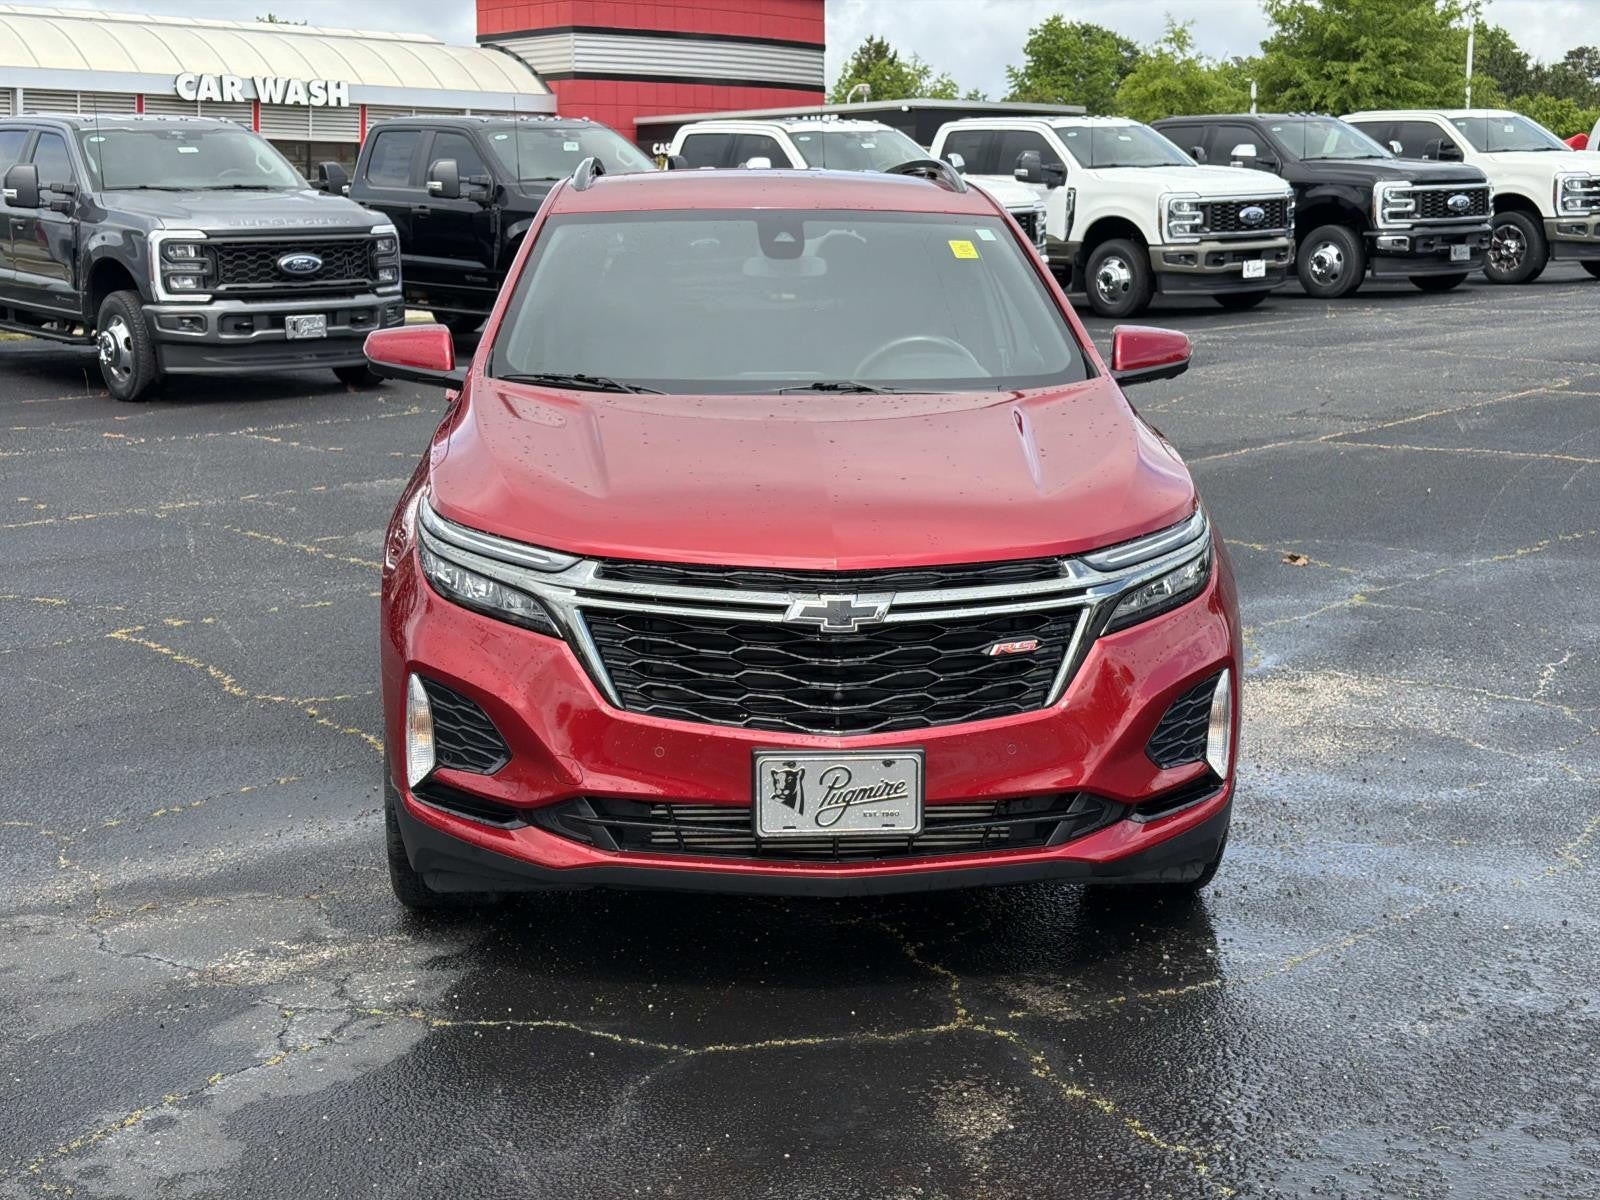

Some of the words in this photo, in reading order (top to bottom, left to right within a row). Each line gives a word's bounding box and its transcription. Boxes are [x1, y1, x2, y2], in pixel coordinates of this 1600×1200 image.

[175, 72, 245, 102] CAR
[252, 76, 349, 107] WASH
[990, 640, 1038, 656] RS
[815, 765, 908, 827] Pugmire
